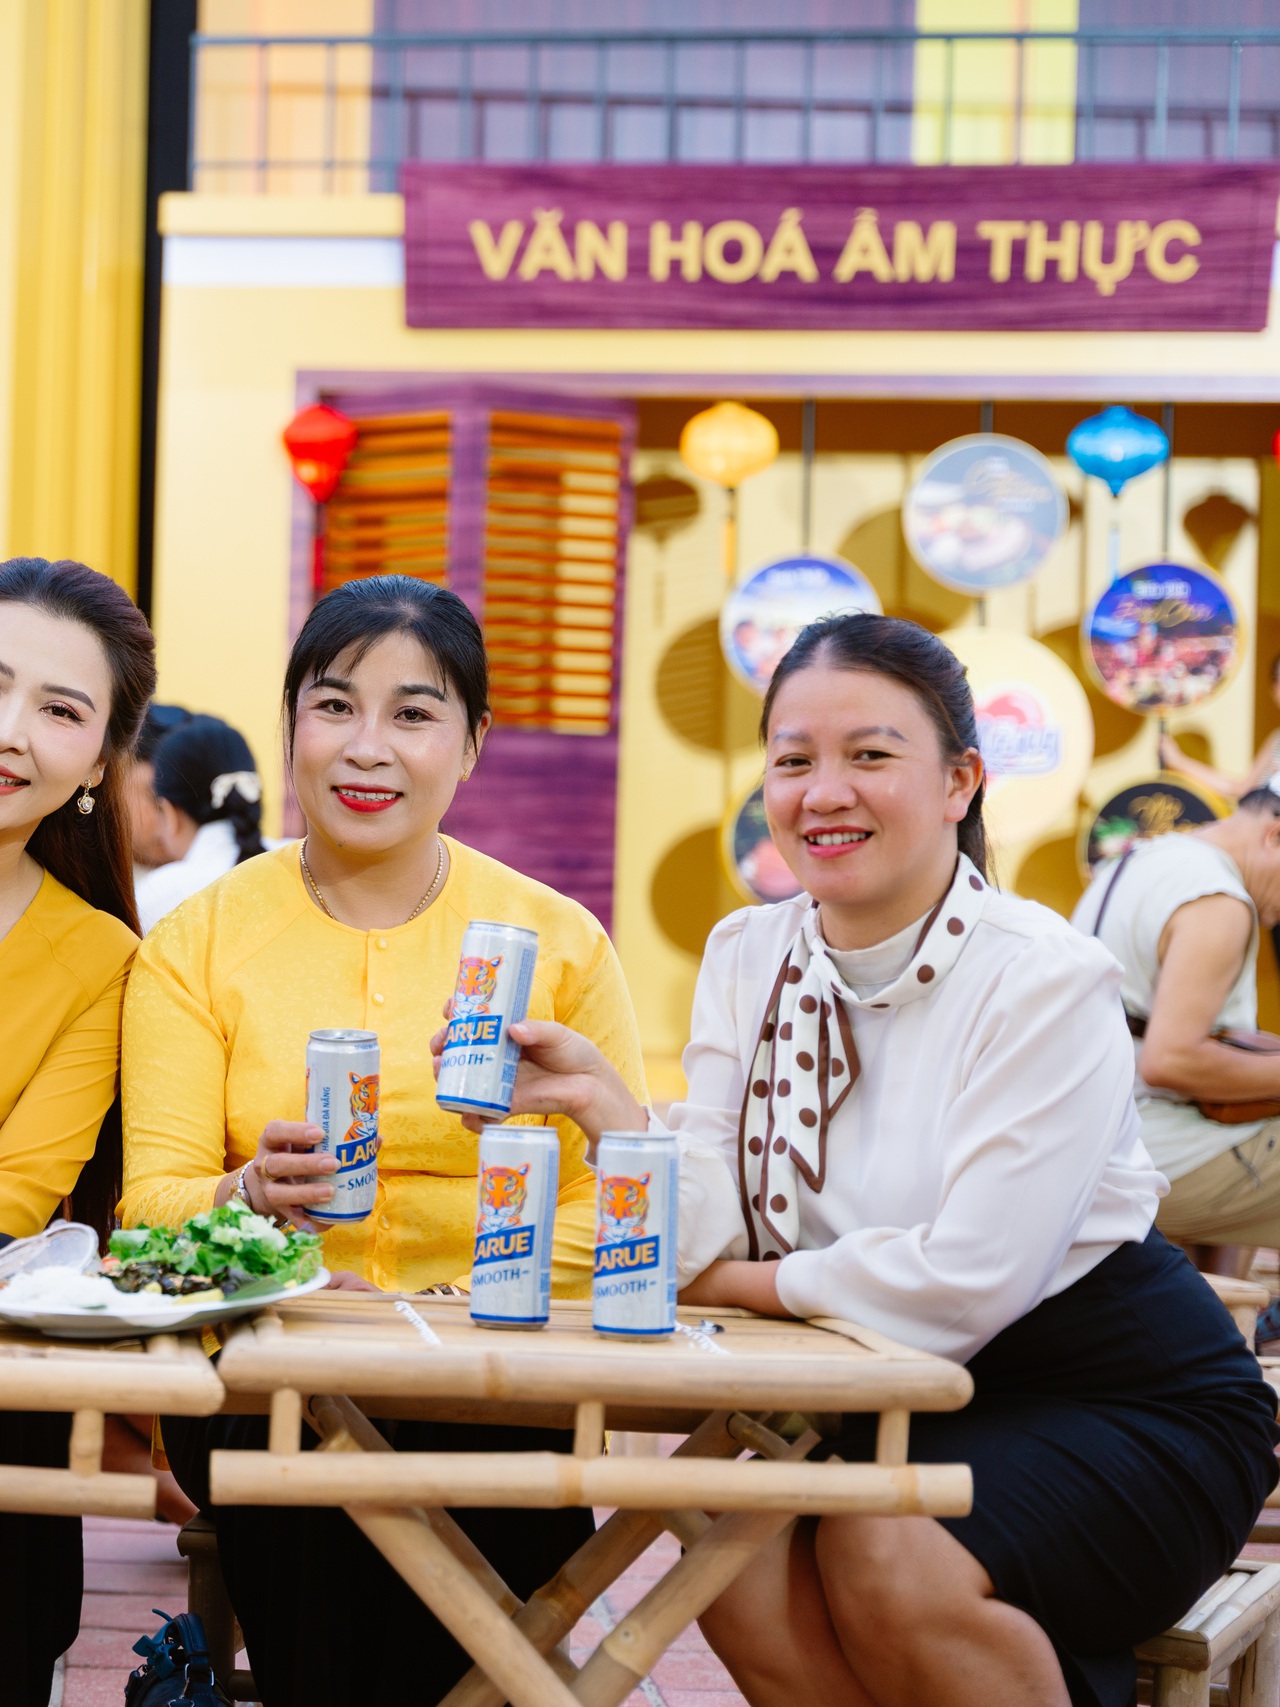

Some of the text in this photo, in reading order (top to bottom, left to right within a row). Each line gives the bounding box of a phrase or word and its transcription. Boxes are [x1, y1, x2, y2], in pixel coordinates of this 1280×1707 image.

[468, 206, 628, 282] VĂN
[649, 206, 819, 284] HOÁ
[976, 218, 1202, 297] THỰC
[445, 1021, 497, 1044] ARUE
[442, 1053, 484, 1068] MOOTH
[347, 1169, 376, 1191] SMOO
